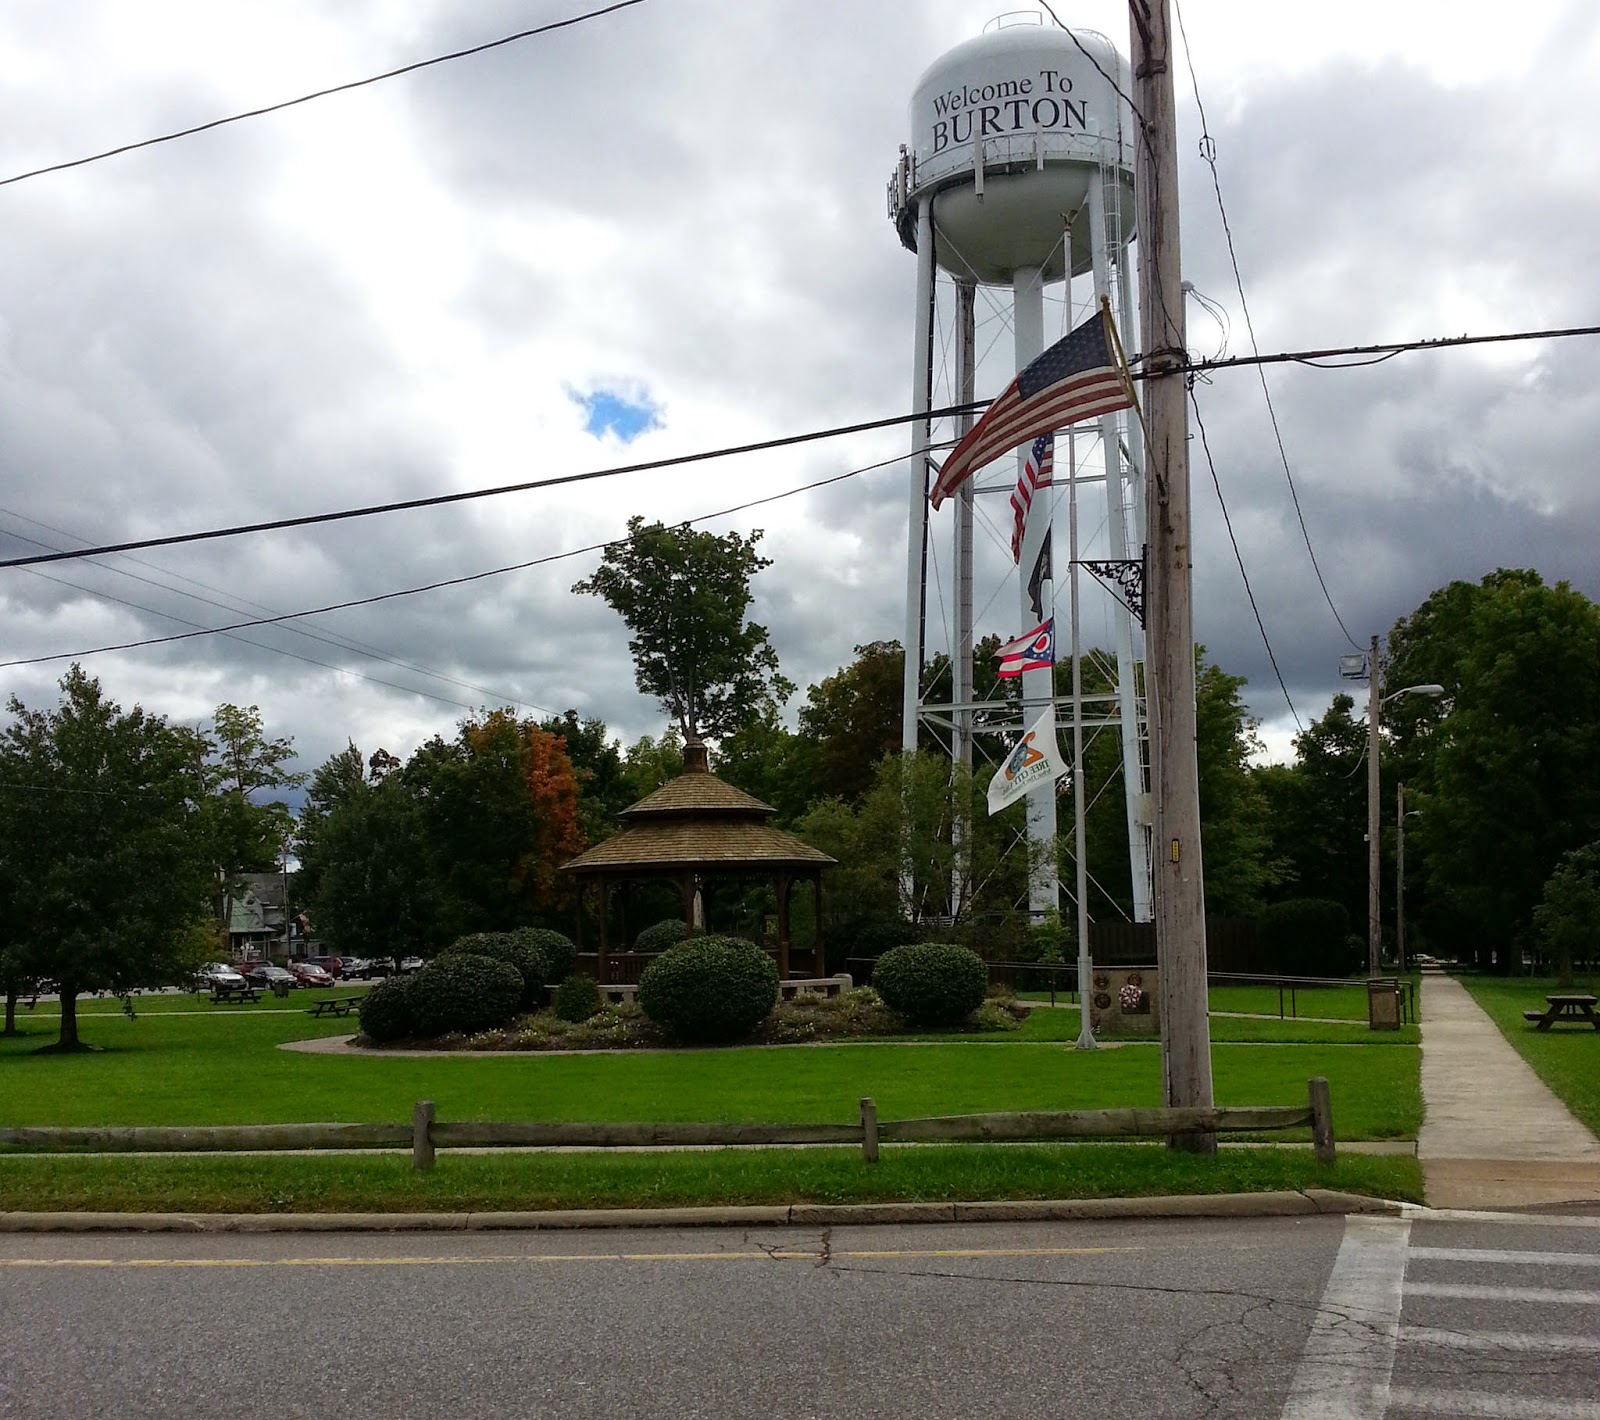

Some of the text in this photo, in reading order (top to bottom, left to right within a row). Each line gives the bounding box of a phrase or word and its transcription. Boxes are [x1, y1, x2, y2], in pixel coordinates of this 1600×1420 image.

[933, 70, 1073, 118] Welcome To
[932, 98, 1088, 154] BURTON
